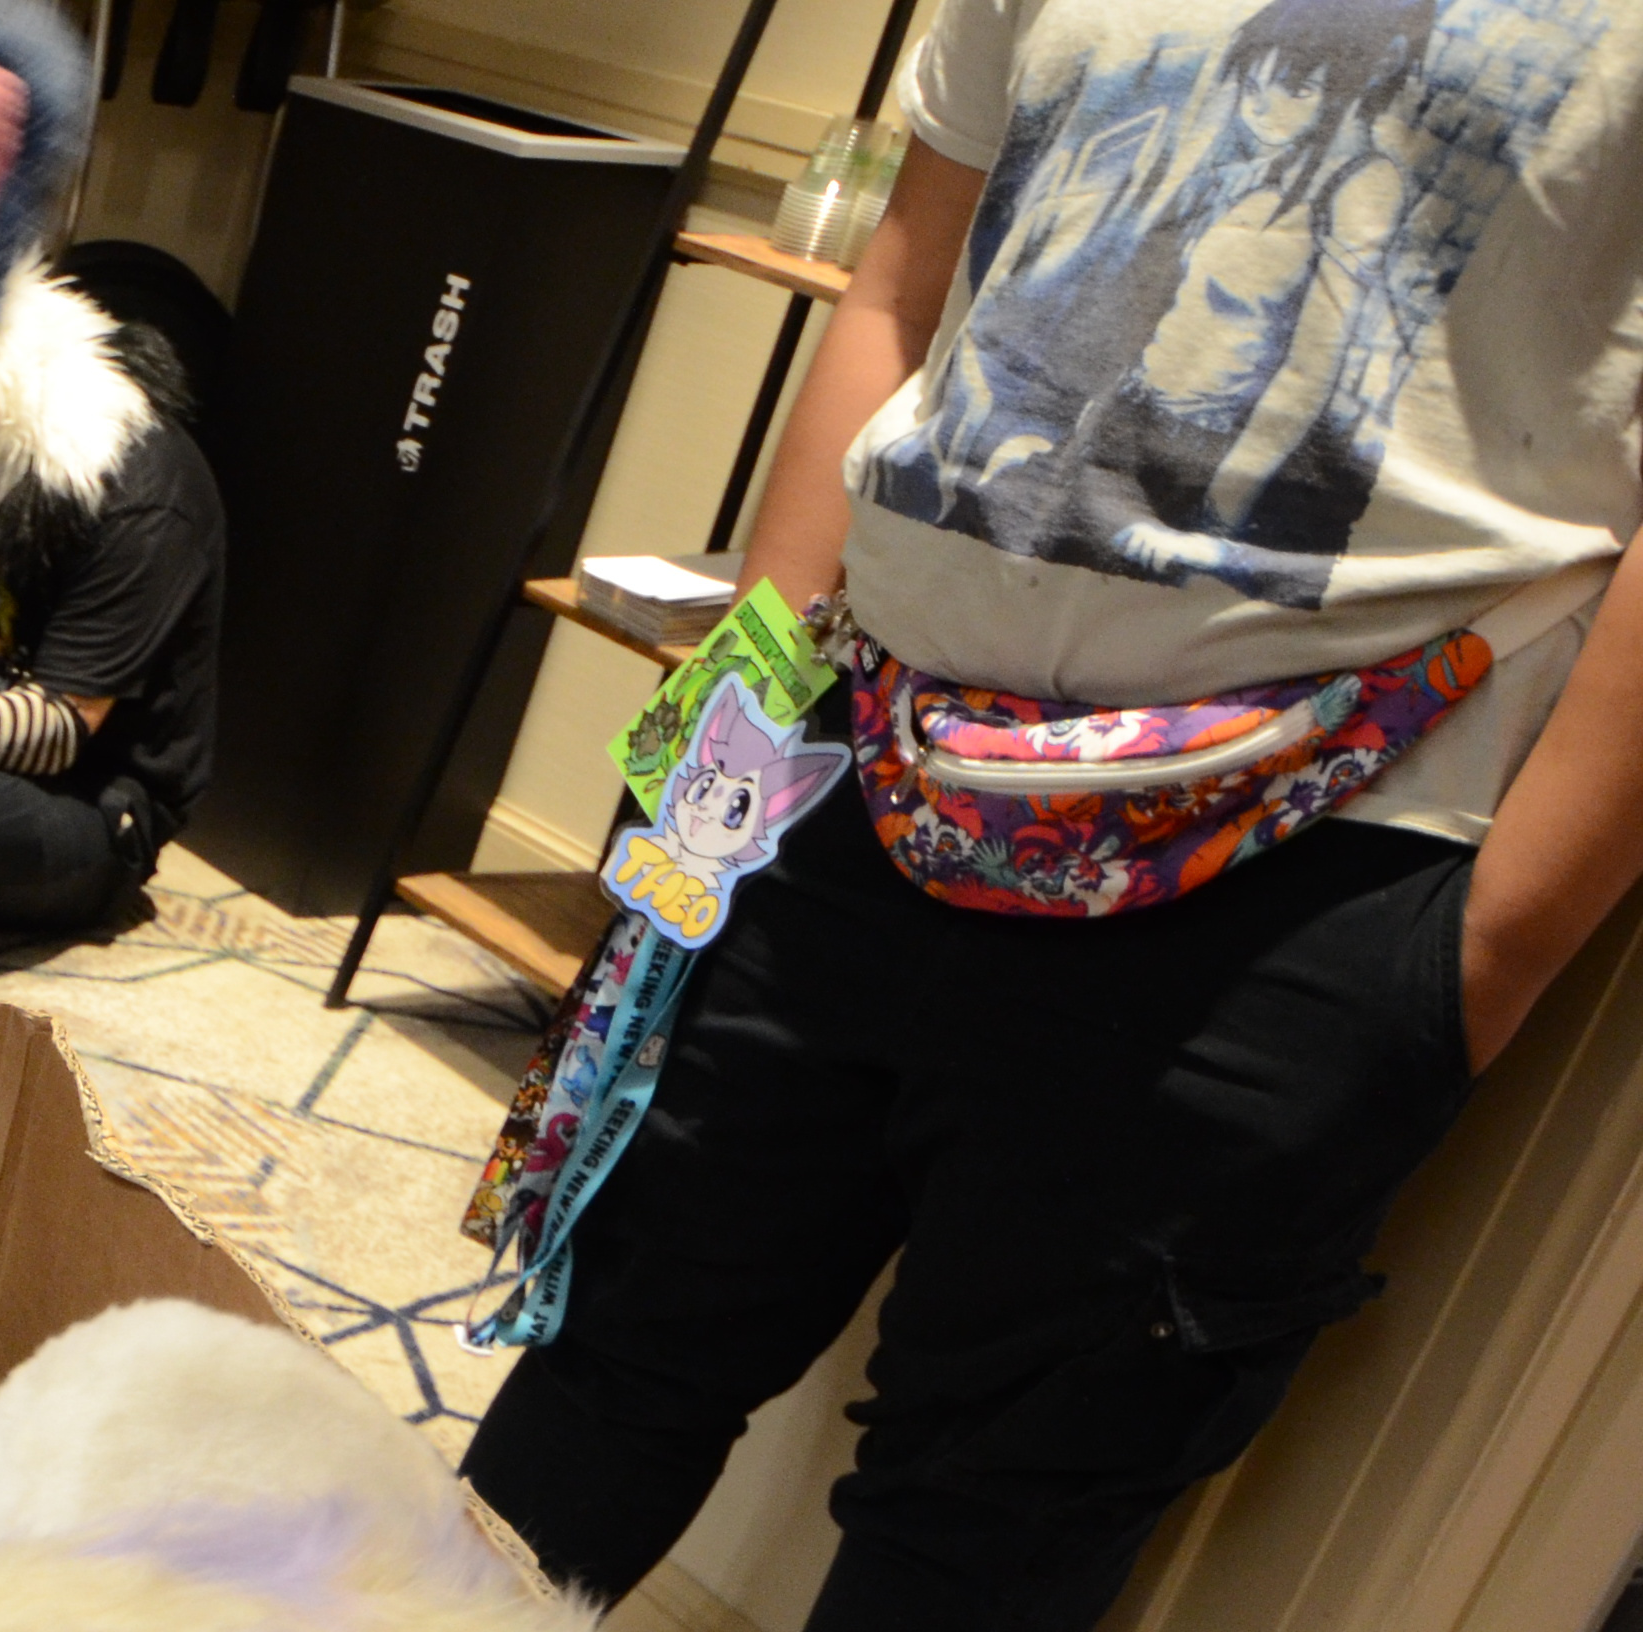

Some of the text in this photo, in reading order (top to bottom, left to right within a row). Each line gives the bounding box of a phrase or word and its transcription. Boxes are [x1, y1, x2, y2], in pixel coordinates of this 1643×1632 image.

[402, 273, 472, 432] TRASH
[615, 835, 720, 939] THEO
[634, 938, 674, 1010] EEKING
[583, 1097, 636, 1168] SEEKING
[562, 1169, 590, 1214] NEW
[540, 1259, 565, 1306] WITH
